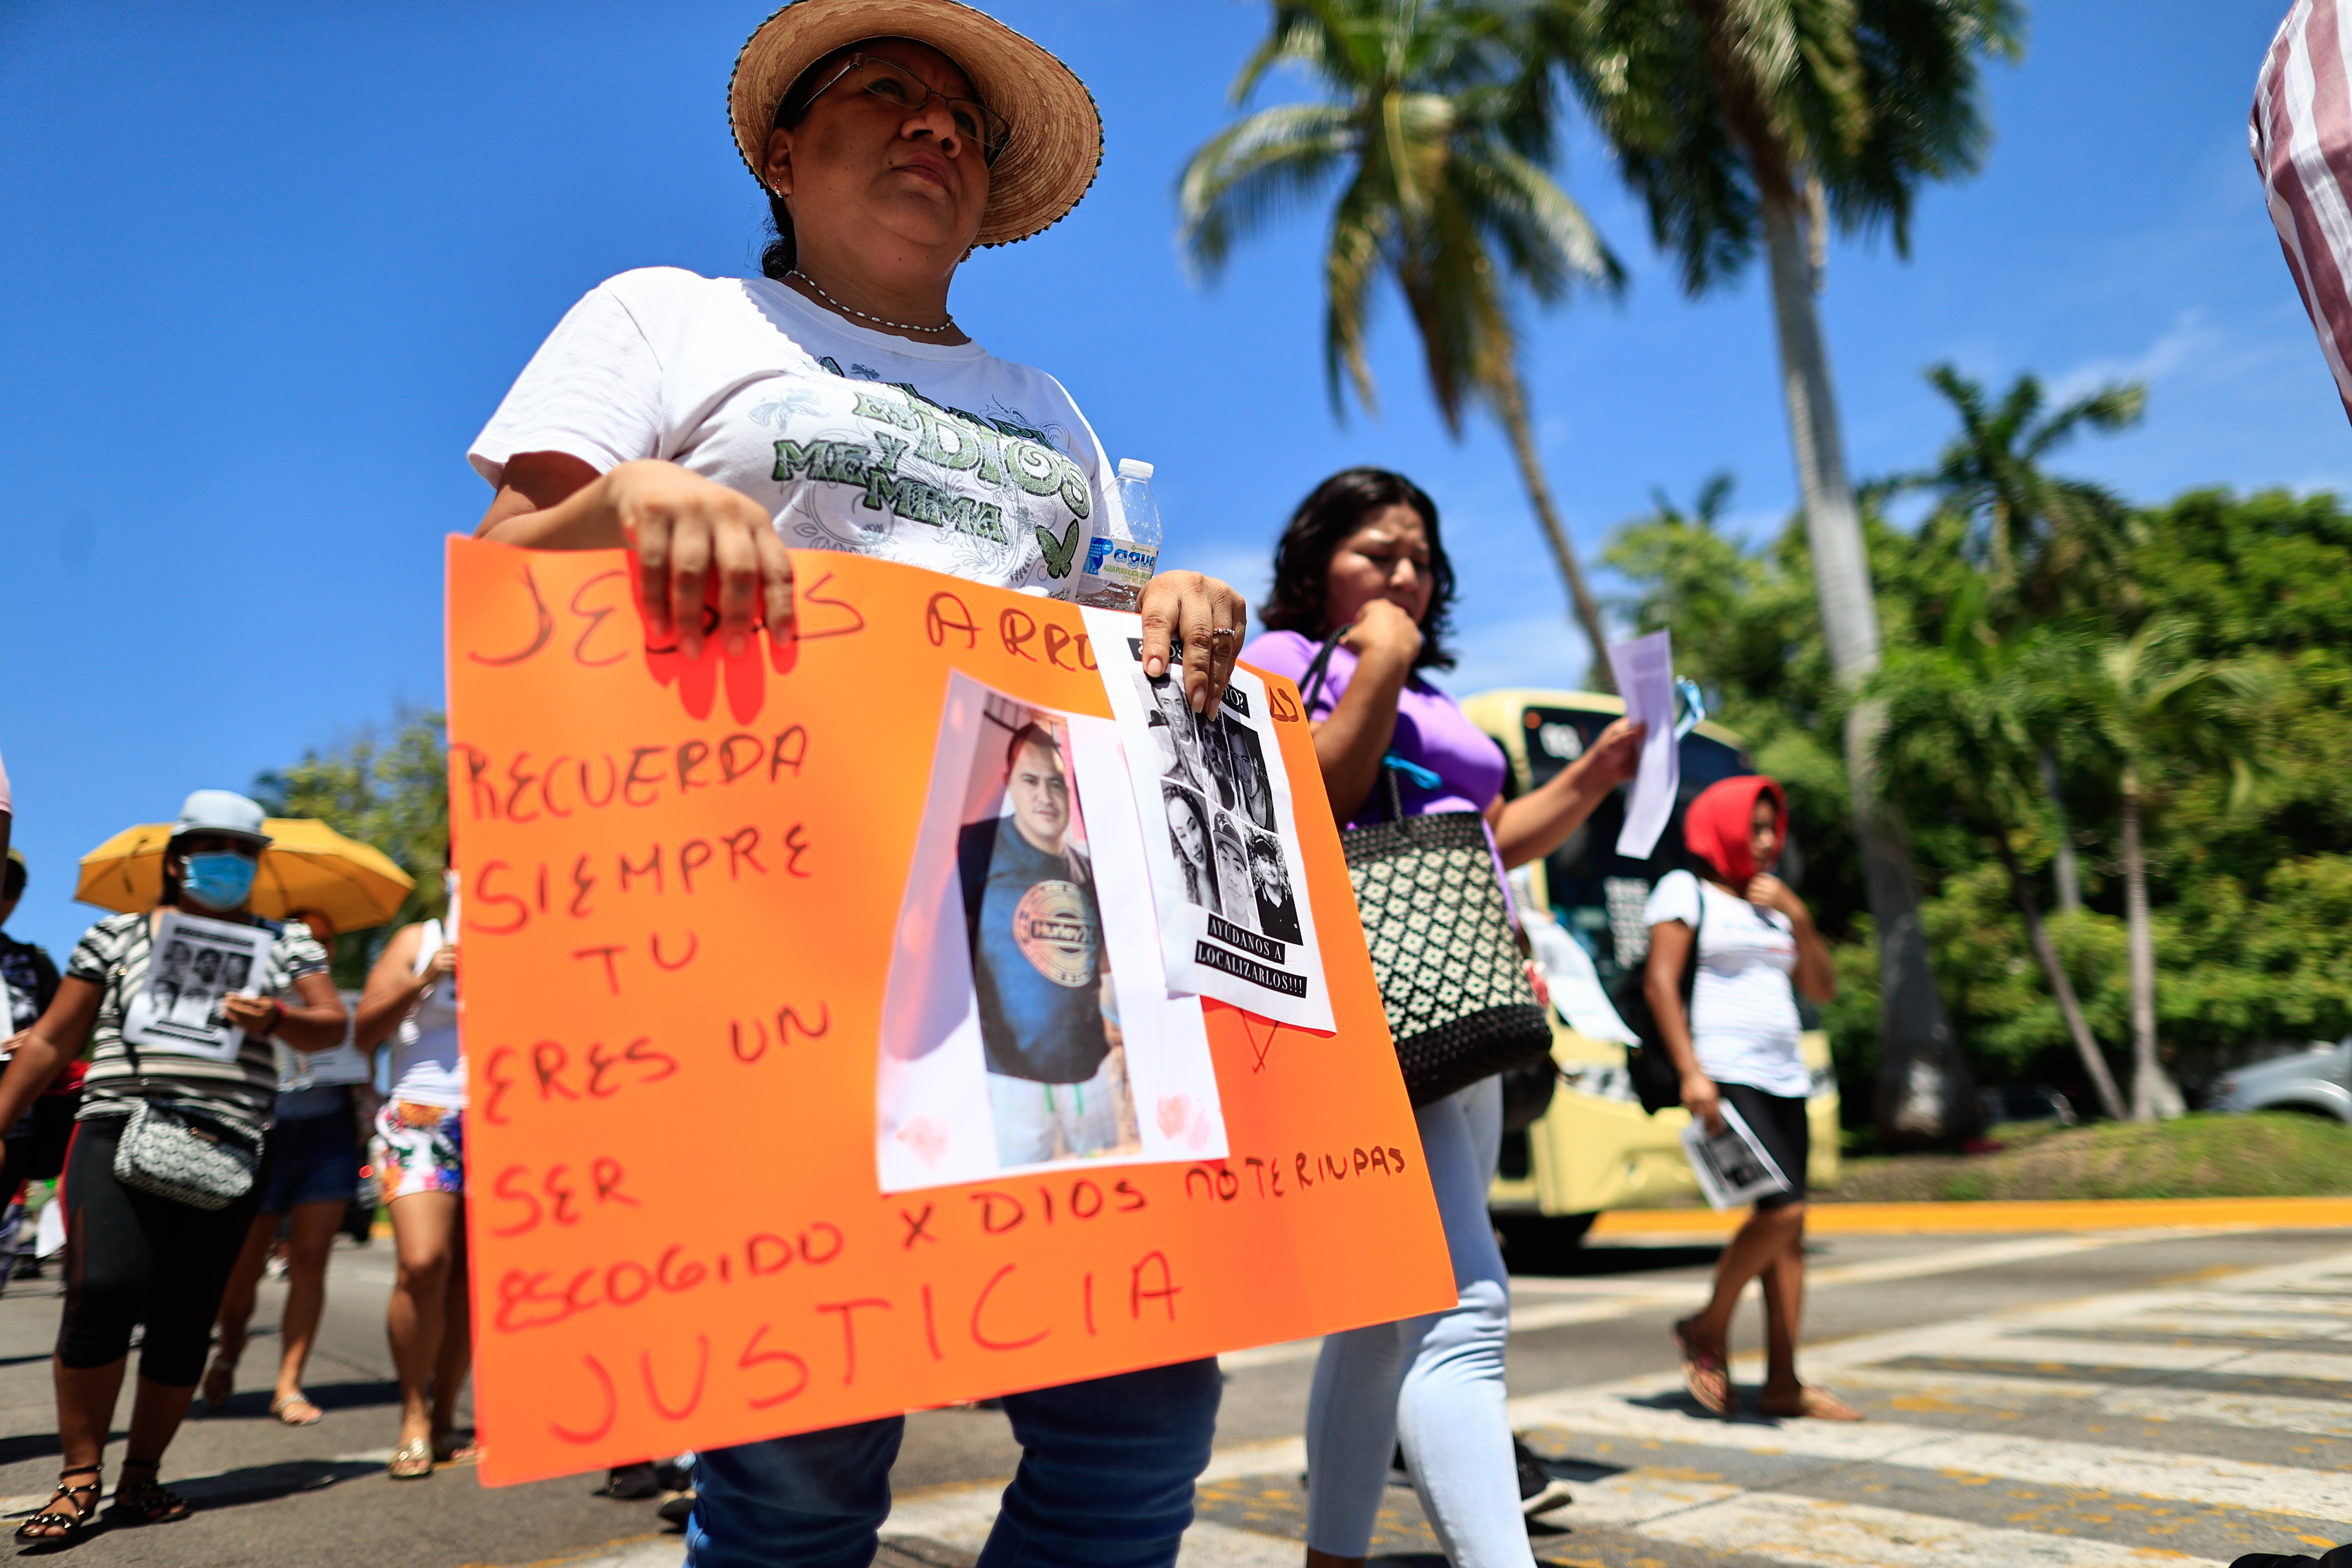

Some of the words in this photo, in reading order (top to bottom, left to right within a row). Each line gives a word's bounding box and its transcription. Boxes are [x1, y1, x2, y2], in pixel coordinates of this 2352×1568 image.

[915, 407, 1089, 520] DIOS
[1103, 564, 1115, 573] AGUA
[450, 724, 808, 823] RECUERDA
[468, 823, 812, 935] SIEMPRE
[572, 930, 699, 995] TU
[1198, 943, 1303, 994] LOCALIZARLOS!!!
[1210, 918, 1269, 956] AYÚDANOS
[1274, 946, 1282, 961] A
[484, 1036, 679, 1125] ERES
[730, 1001, 832, 1062] UN
[490, 1156, 642, 1238] SER
[494, 1221, 845, 1333] ESCOGIDO
[971, 1179, 1147, 1235] DIOS
[550, 1250, 1183, 1444] JUSTICIA
